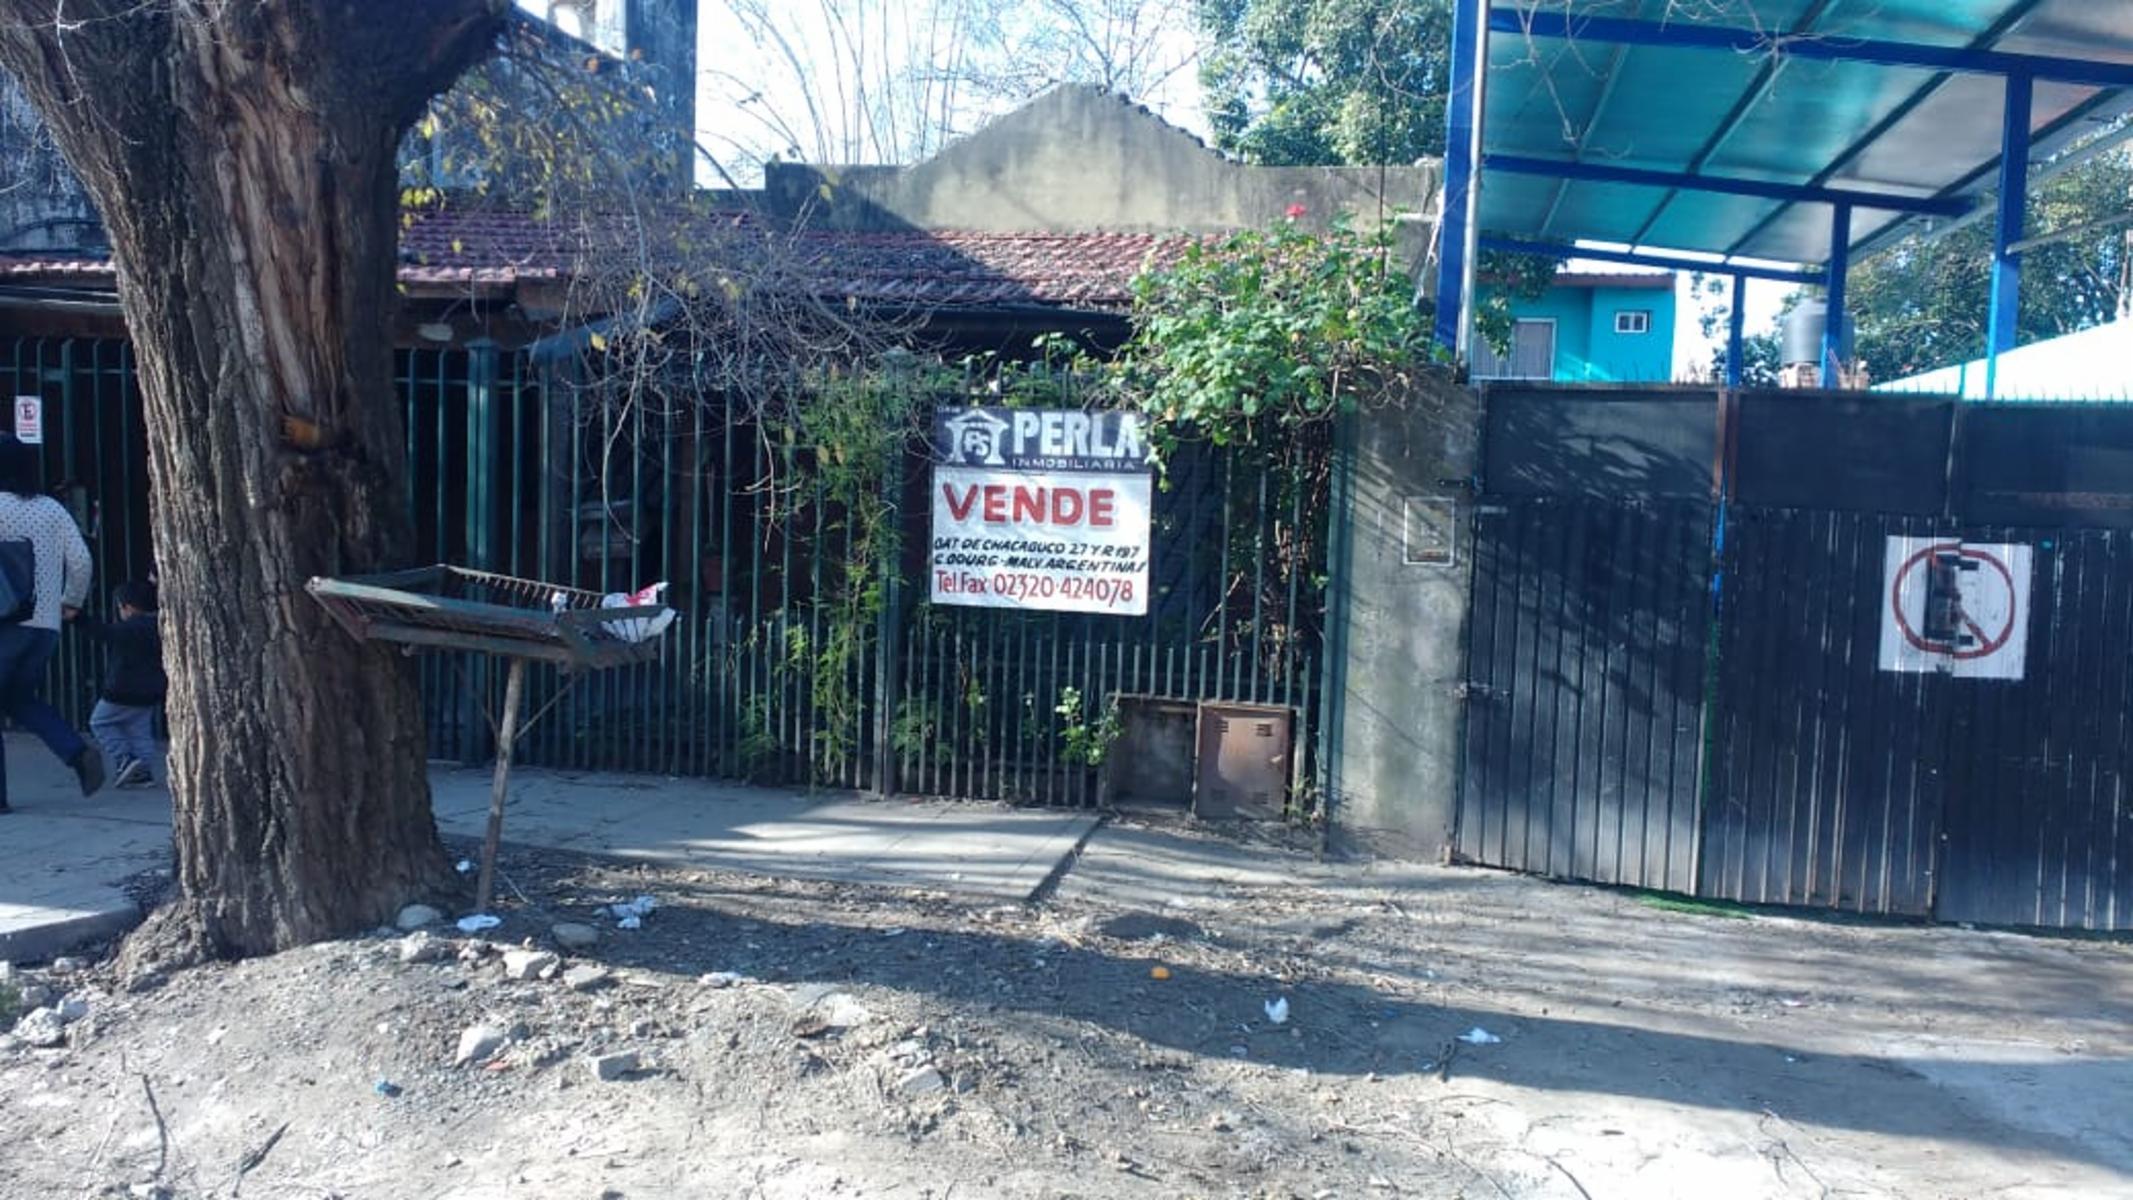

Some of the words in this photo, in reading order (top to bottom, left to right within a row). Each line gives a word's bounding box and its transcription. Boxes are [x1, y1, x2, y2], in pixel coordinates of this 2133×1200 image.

[1013, 411, 1140, 458] PERLA
[1012, 458, 1136, 470] INMOBILIARIA
[943, 482, 1114, 526] VENDE
[961, 538, 981, 551] DE
[982, 539, 1065, 555] CHACABUCO
[1069, 543, 1088, 555] 27
[1090, 545, 1101, 556] Y
